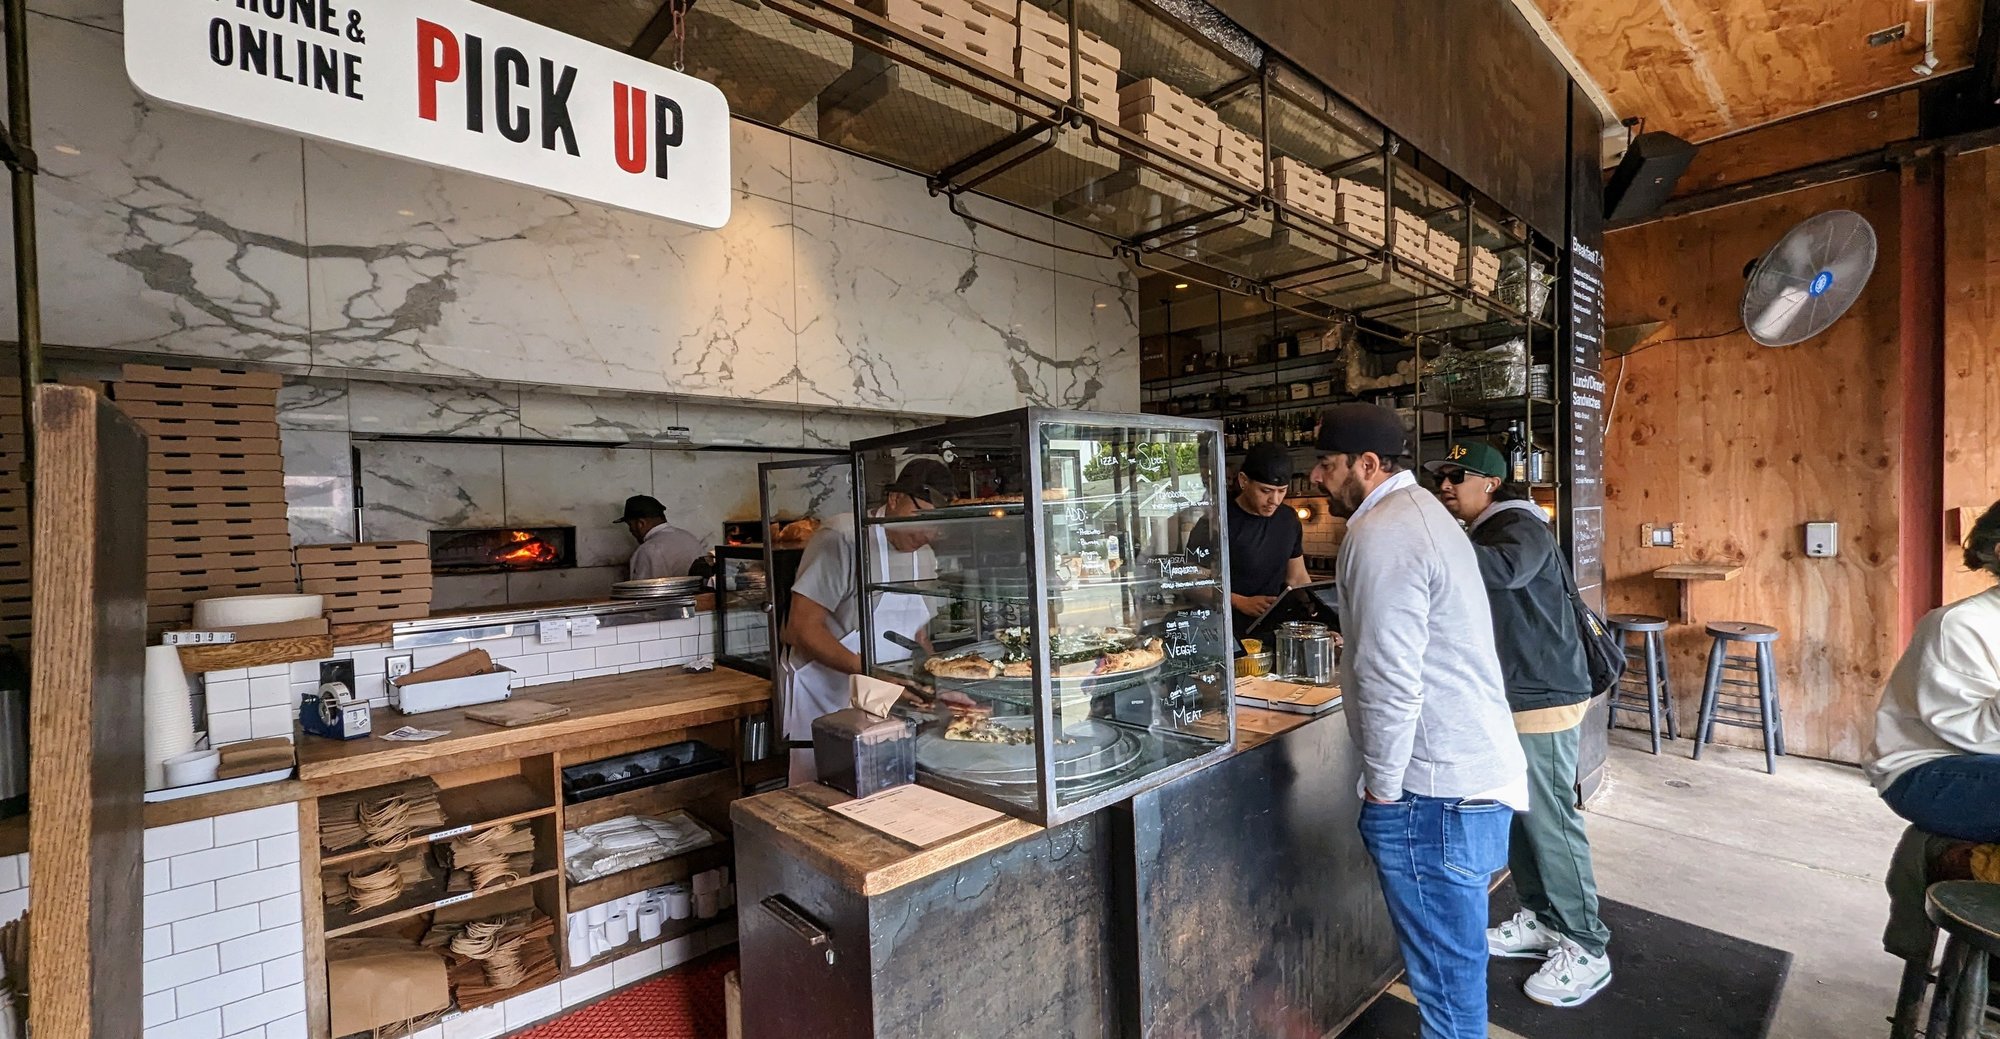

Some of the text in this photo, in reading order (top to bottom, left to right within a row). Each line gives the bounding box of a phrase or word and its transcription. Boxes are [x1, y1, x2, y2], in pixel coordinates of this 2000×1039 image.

[346, 9, 366, 45] &
[209, 17, 364, 101] ONLINE
[416, 17, 684, 180] PICK UP
[1572, 236, 1595, 264] Breakfast
[1572, 391, 1601, 410] Sandwiches
[1445, 444, 1467, 460] A's
[1065, 508, 1088, 521] ADD:
[1166, 636, 1198, 658] VEGGIE
[1172, 705, 1203, 729] MEAT
